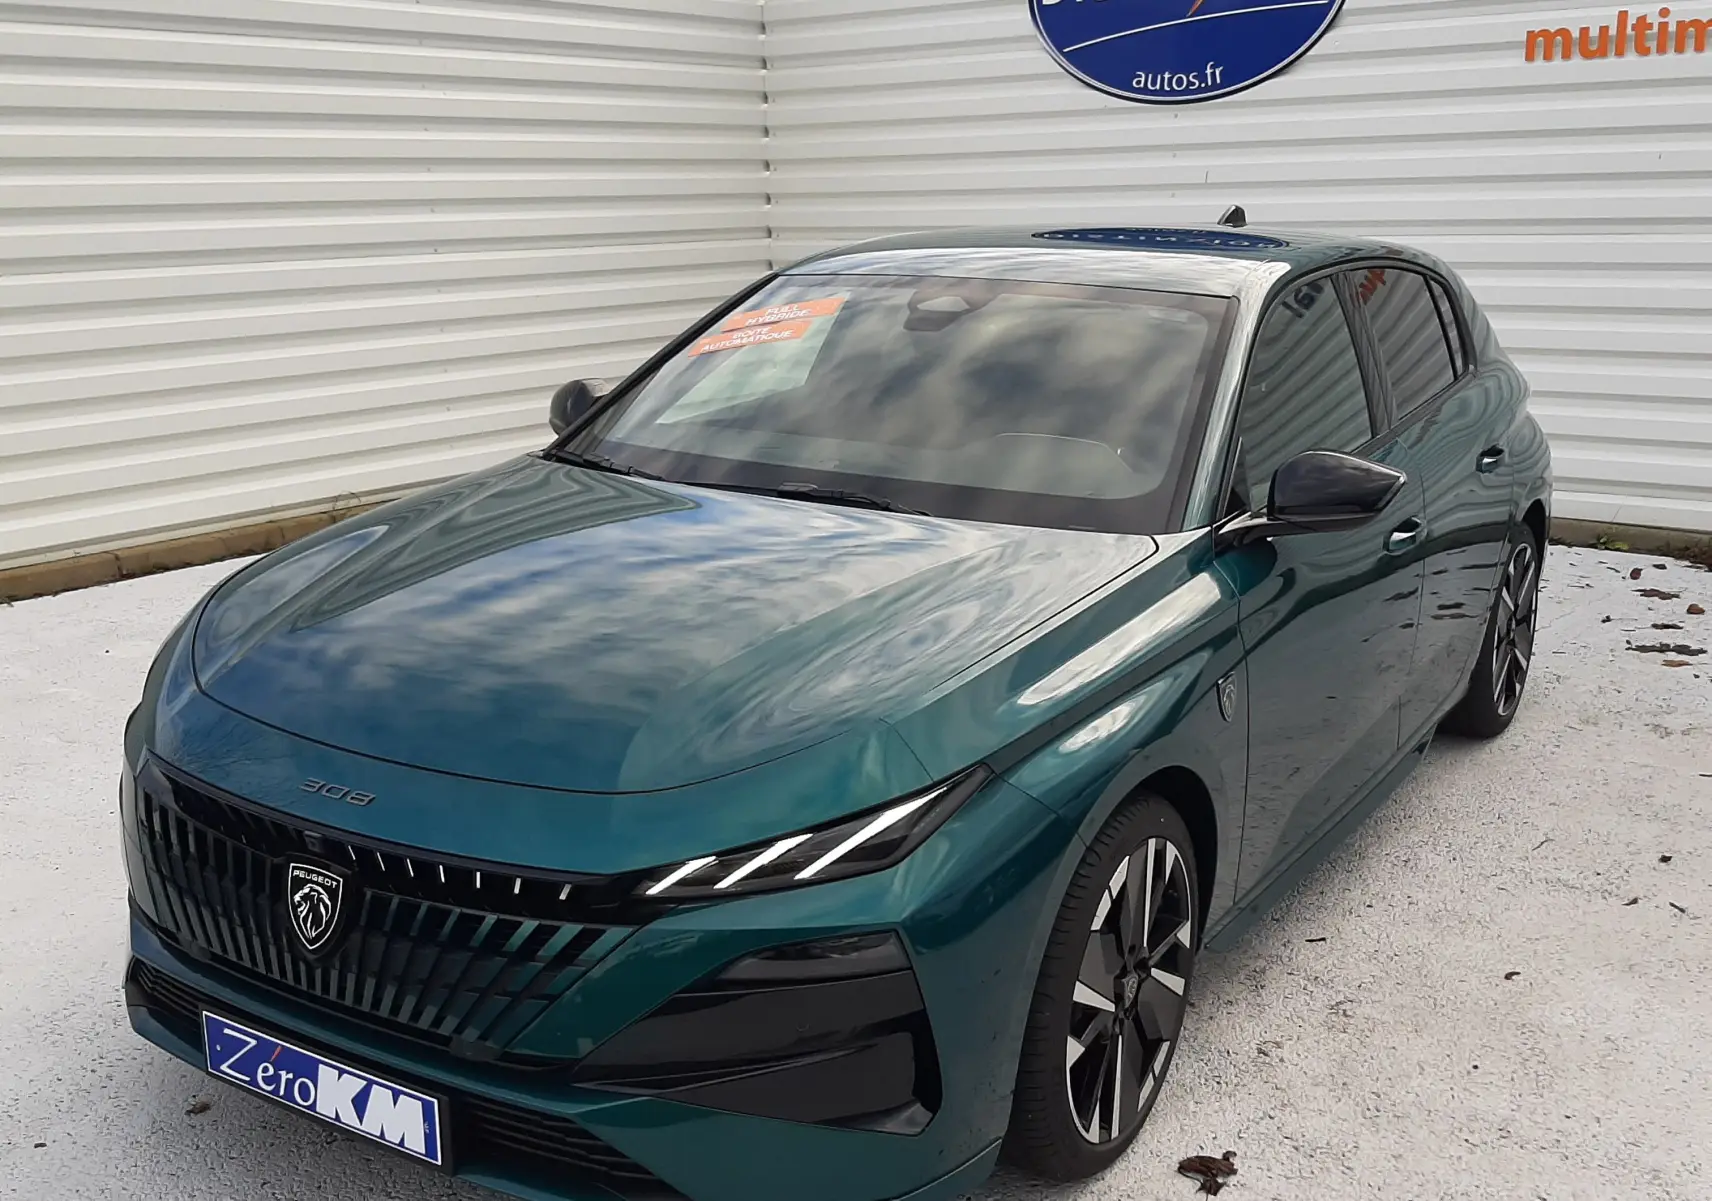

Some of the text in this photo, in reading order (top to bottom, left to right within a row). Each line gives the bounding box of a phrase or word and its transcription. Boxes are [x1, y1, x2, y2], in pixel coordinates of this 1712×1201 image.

[1525, 7, 1712, 63] multim
[1132, 62, 1224, 91] autos.fr
[745, 309, 812, 325] HYBRIDE
[765, 304, 799, 315] FULL
[700, 330, 794, 352] AUTOMATIQUE
[300, 777, 376, 806] 308
[293, 869, 338, 889] PEUGEOT
